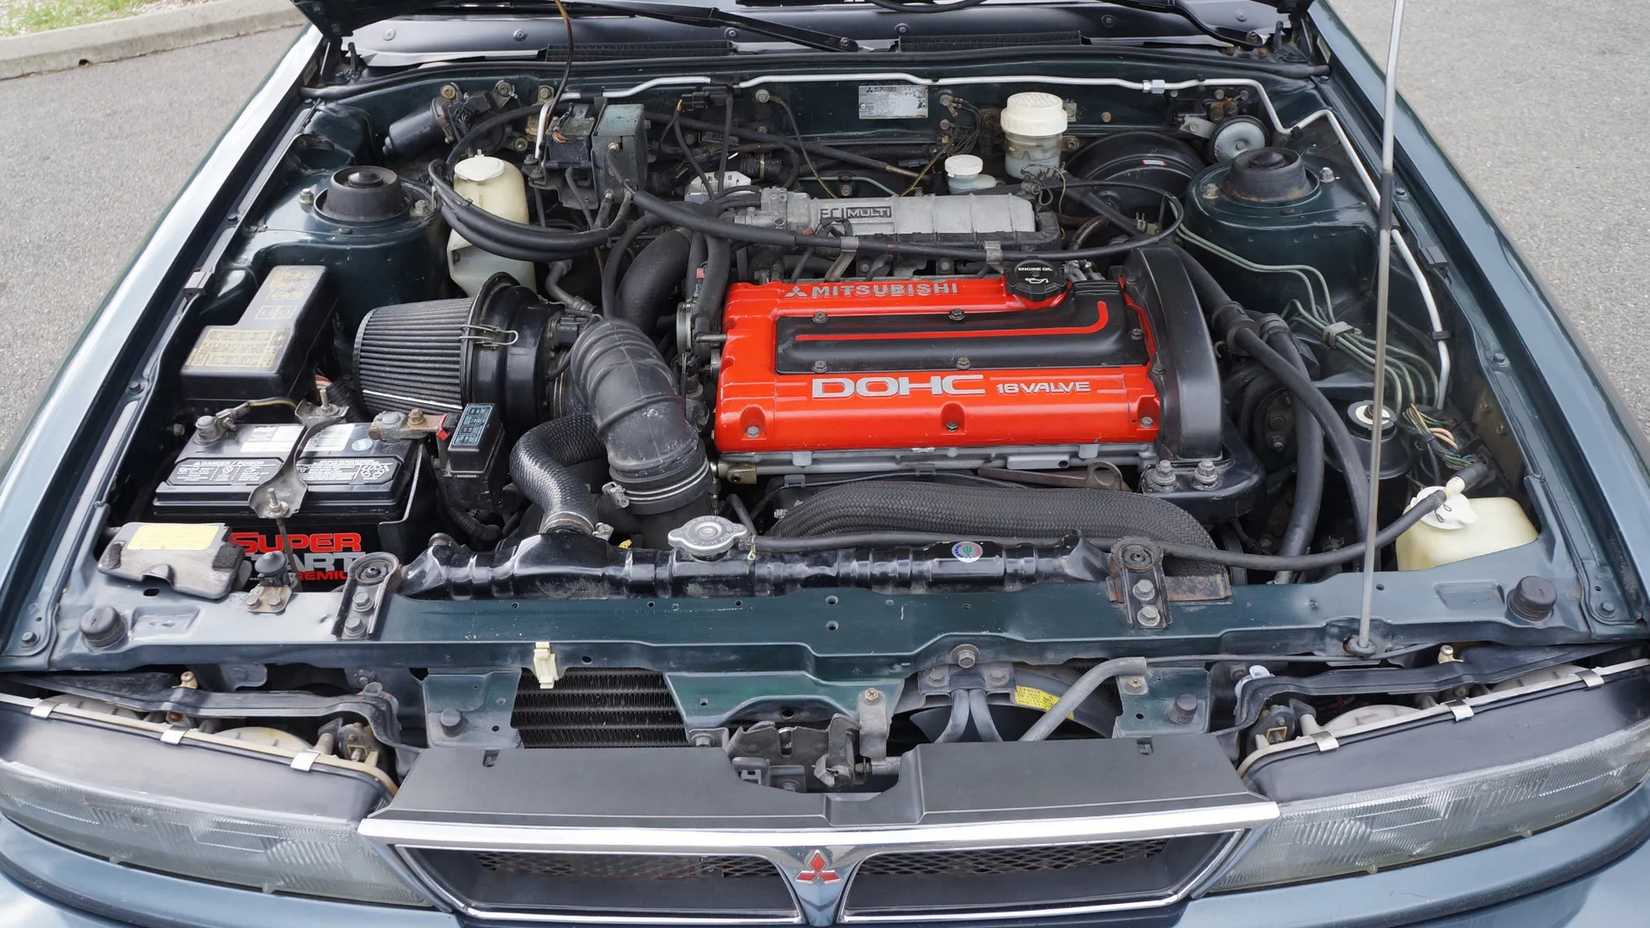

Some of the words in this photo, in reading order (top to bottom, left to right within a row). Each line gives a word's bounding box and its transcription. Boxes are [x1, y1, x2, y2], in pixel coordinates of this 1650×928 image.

[847, 208, 891, 217] MULTI
[811, 283, 958, 299] MITSUBISHI
[811, 374, 986, 399] DOHC
[229, 531, 362, 553] SUPER
